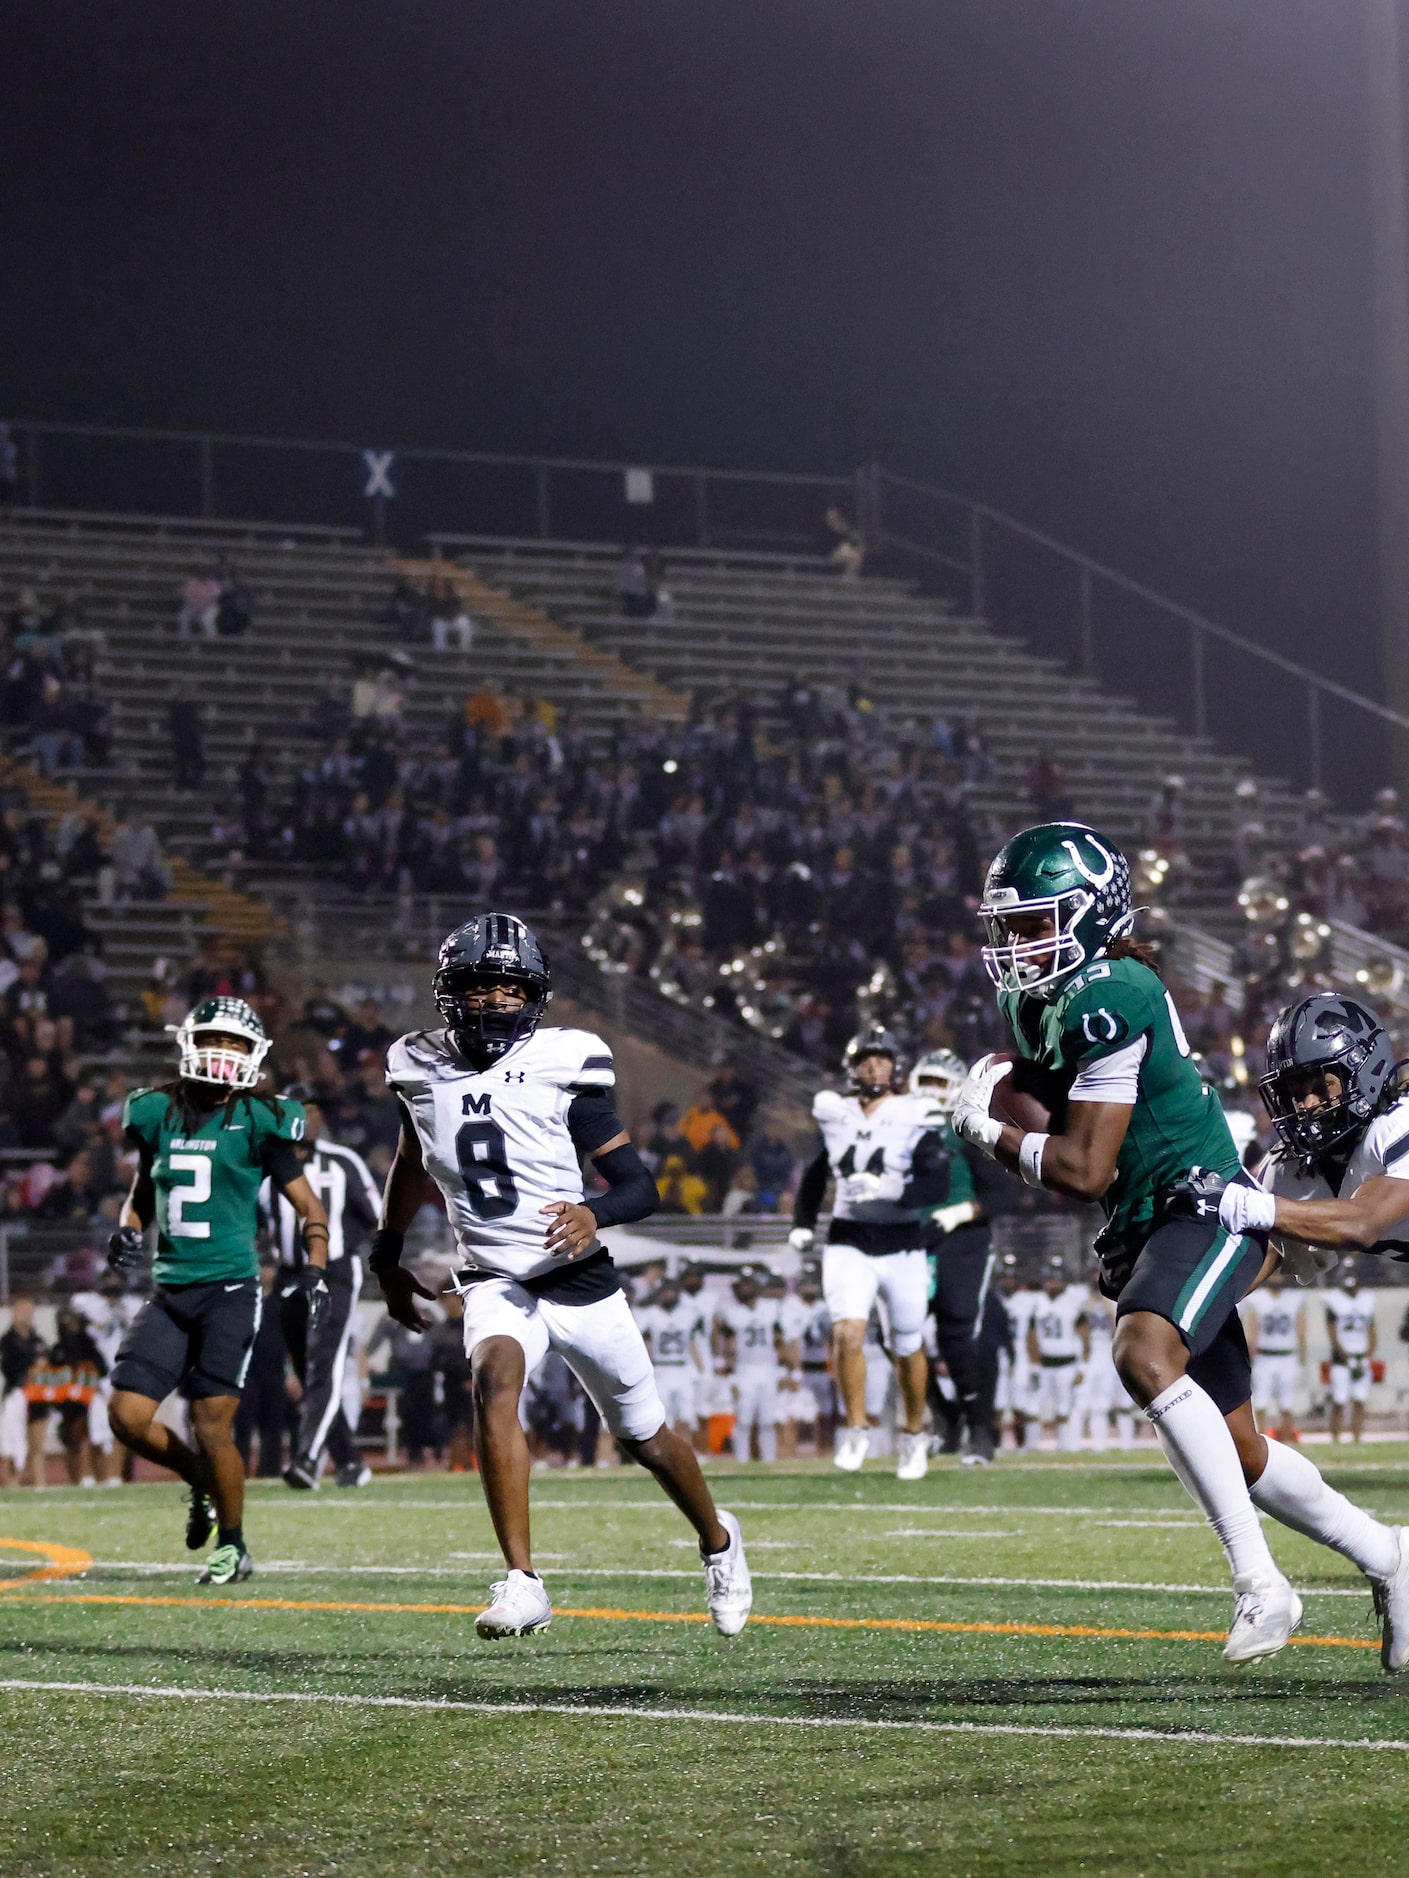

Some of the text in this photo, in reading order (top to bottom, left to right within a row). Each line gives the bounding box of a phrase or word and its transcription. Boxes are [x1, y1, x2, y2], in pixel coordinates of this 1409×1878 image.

[462, 1093, 492, 1116] M
[169, 1138, 217, 1151] ARLINGTON
[856, 1130, 872, 1141] M
[455, 1120, 520, 1221] 8
[168, 1154, 212, 1238] 2
